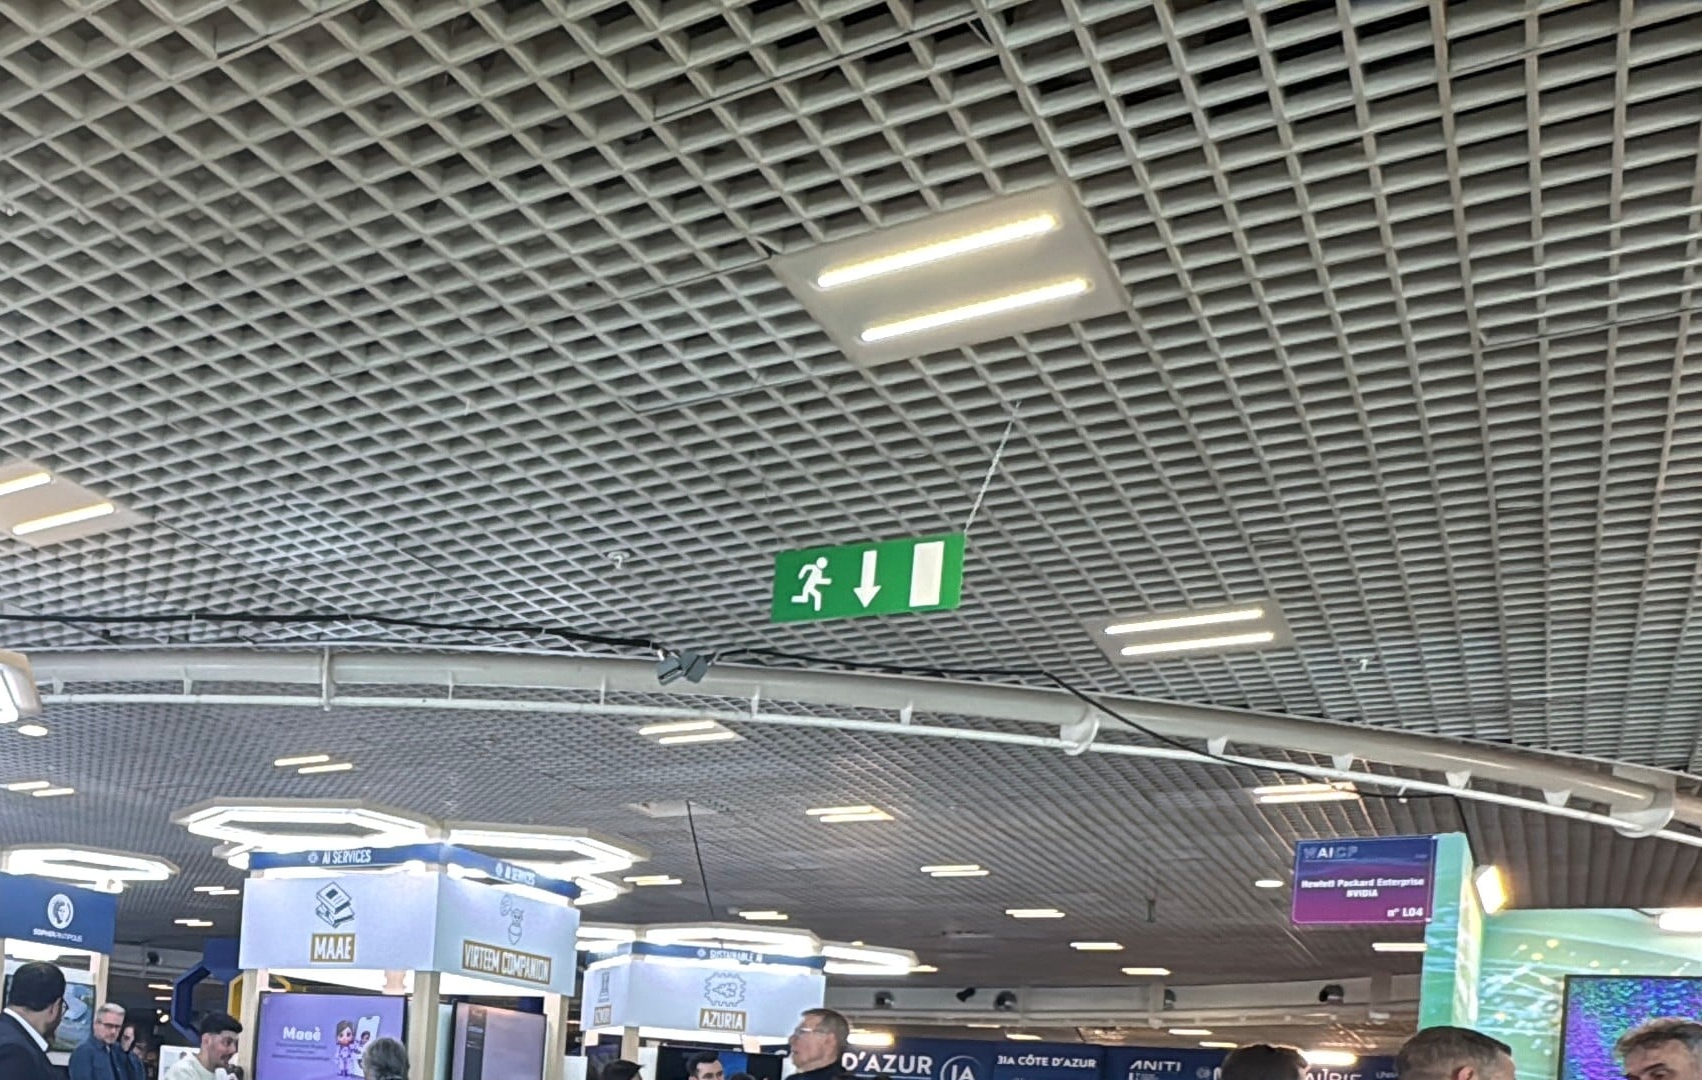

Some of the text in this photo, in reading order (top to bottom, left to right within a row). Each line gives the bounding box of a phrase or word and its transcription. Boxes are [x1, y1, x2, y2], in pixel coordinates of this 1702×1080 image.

[321, 849, 372, 865] AI SERVICES
[1337, 879, 1375, 888] Packard
[1376, 878, 1425, 888] Enterprise
[1402, 907, 1423, 917] L04
[314, 935, 353, 960] MAAE
[464, 943, 549, 982] VIRTEEM COMPANION
[702, 1011, 744, 1030] AZURIA
[841, 1052, 933, 1075] D'AZUR
[1018, 1054, 1049, 1067] CÔTE
[1052, 1057, 1097, 1068] D'AZUR
[1130, 1060, 1181, 1072] ANITI
